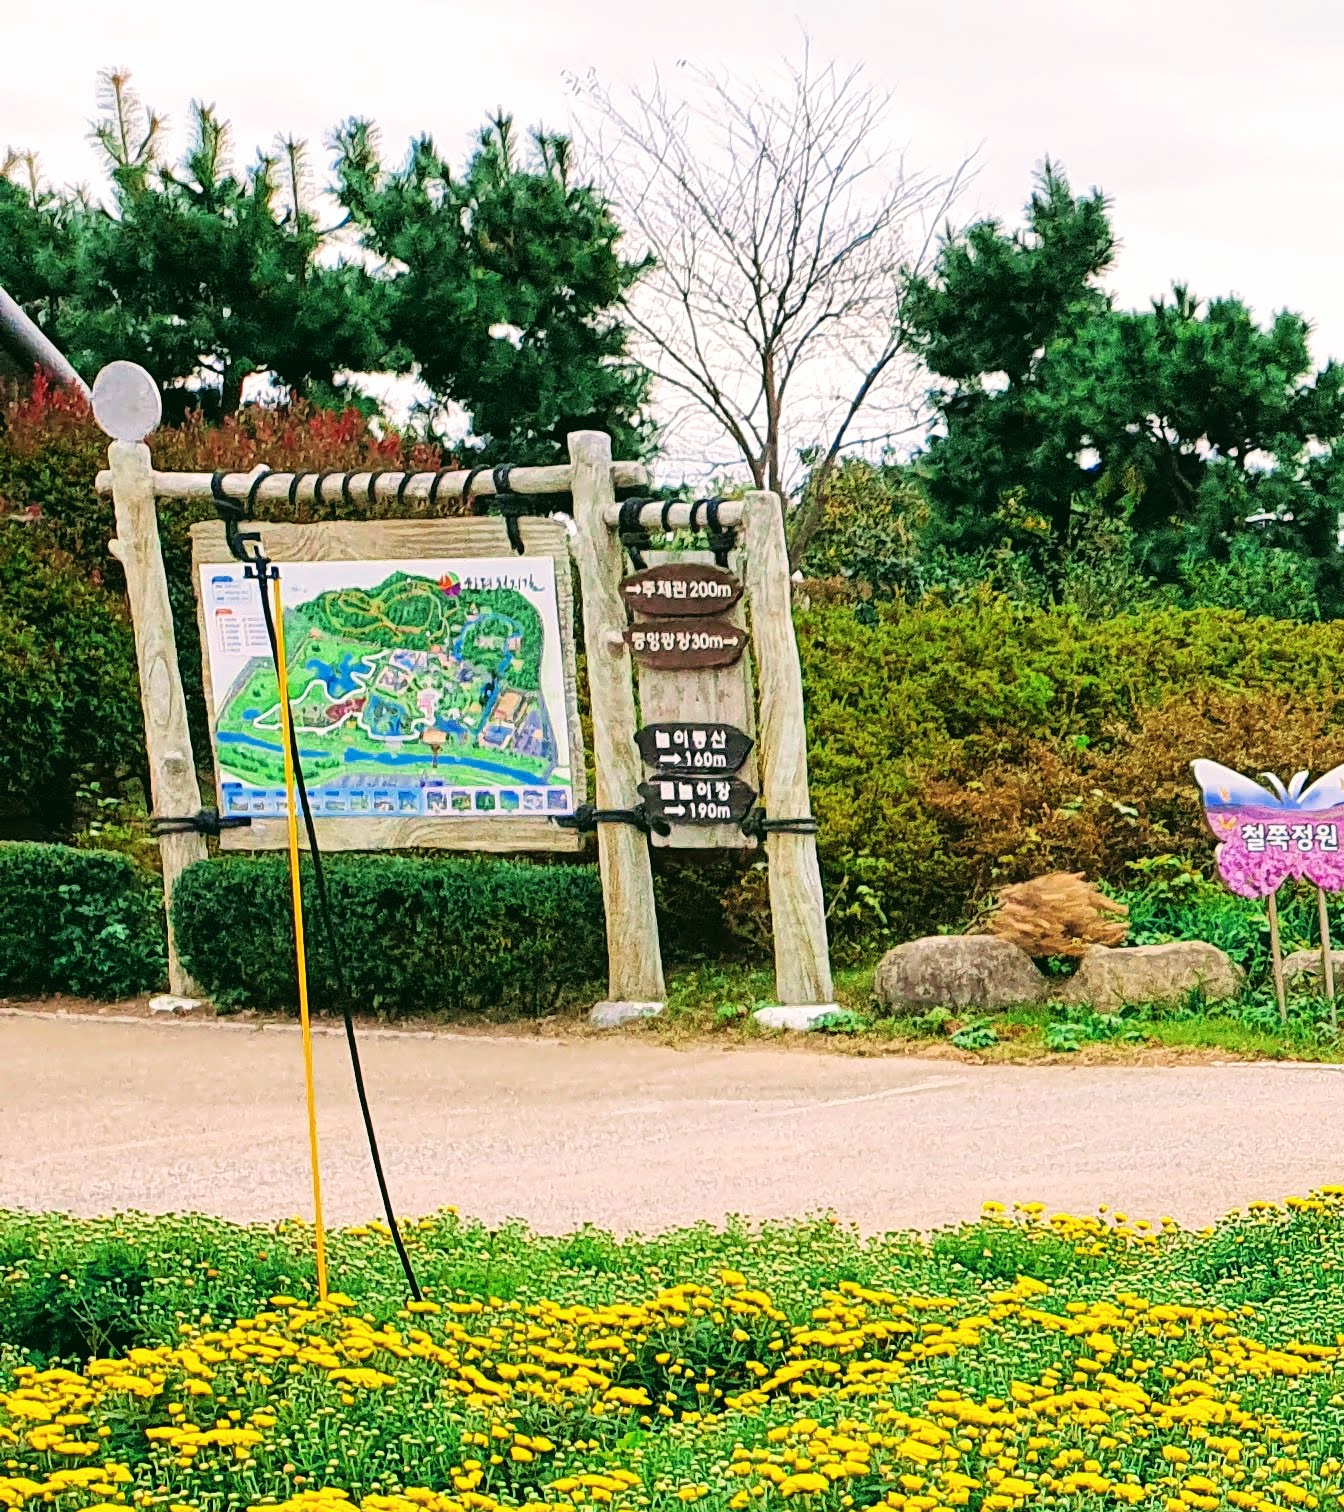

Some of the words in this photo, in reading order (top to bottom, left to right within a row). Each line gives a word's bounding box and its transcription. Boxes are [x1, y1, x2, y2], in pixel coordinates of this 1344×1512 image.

[689, 580, 732, 598] 200m
[691, 632, 723, 649] 30m
[685, 751, 727, 767] 160m
[690, 802, 731, 819] 190m
[1241, 823, 1339, 852] 철쭉정원
